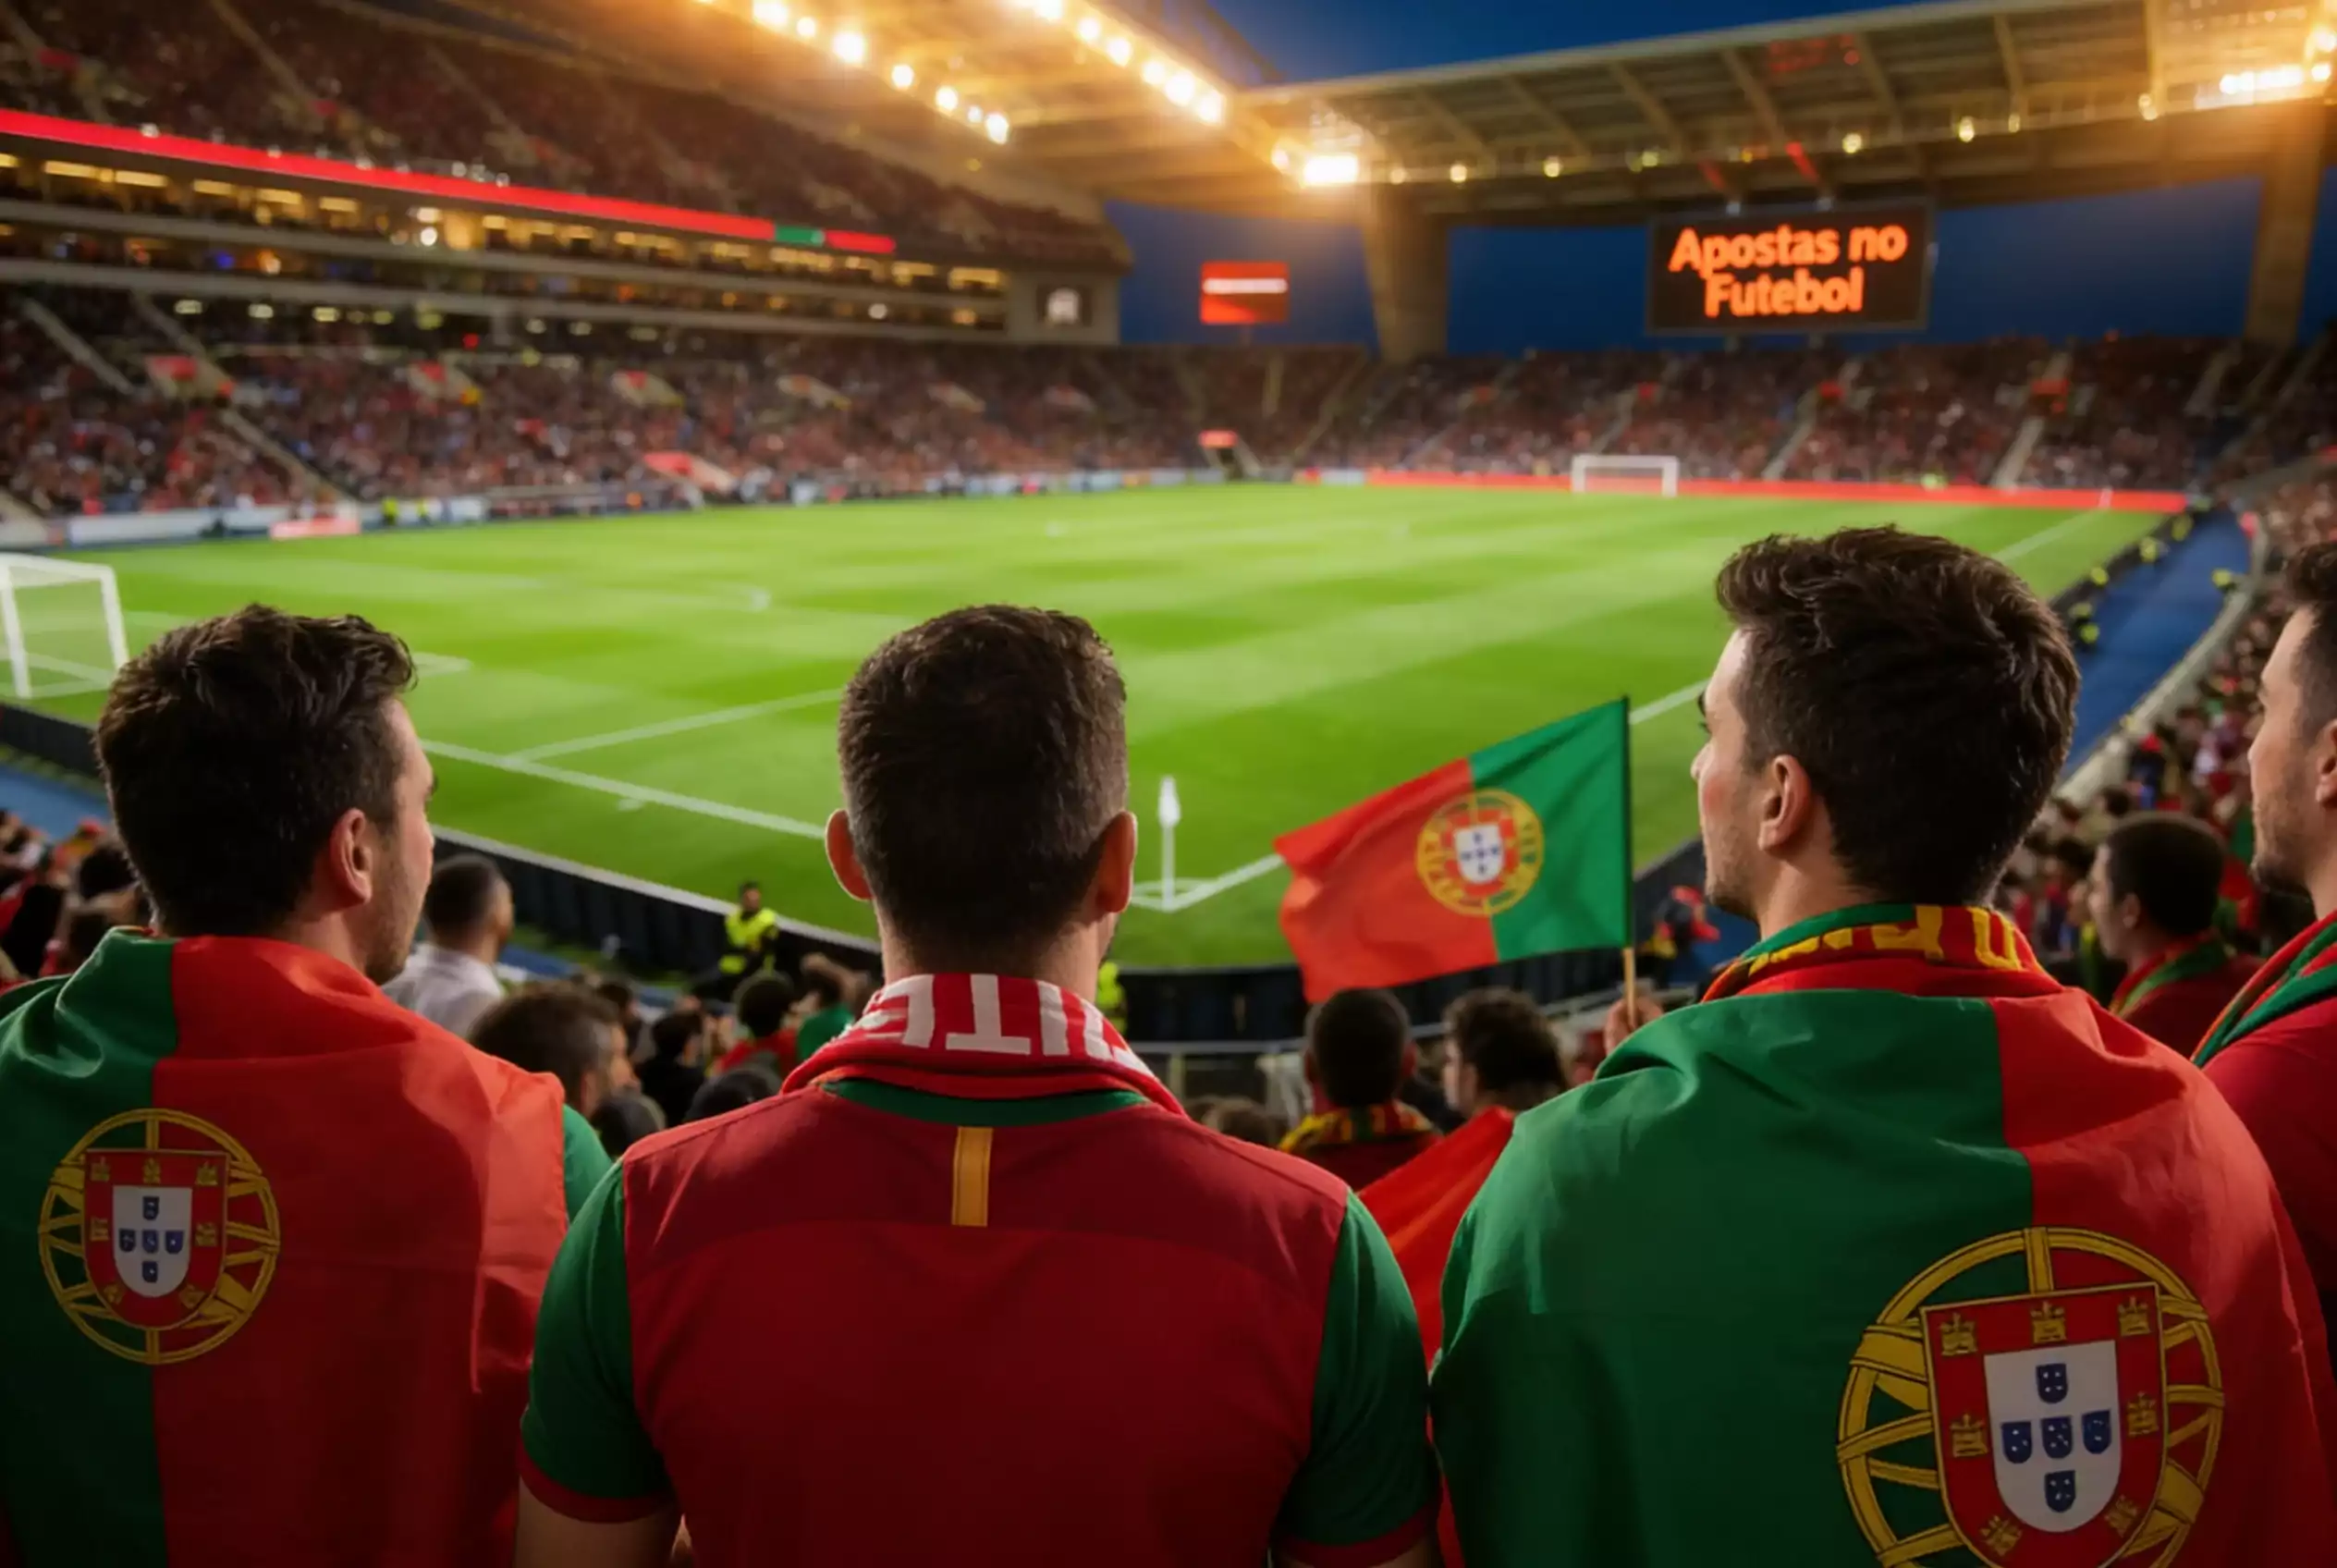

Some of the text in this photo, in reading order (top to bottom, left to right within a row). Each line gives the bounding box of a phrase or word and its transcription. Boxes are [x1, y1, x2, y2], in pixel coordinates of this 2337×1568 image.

[1668, 225, 1908, 279] Apostas no
[1705, 266, 1864, 317] Futebol
